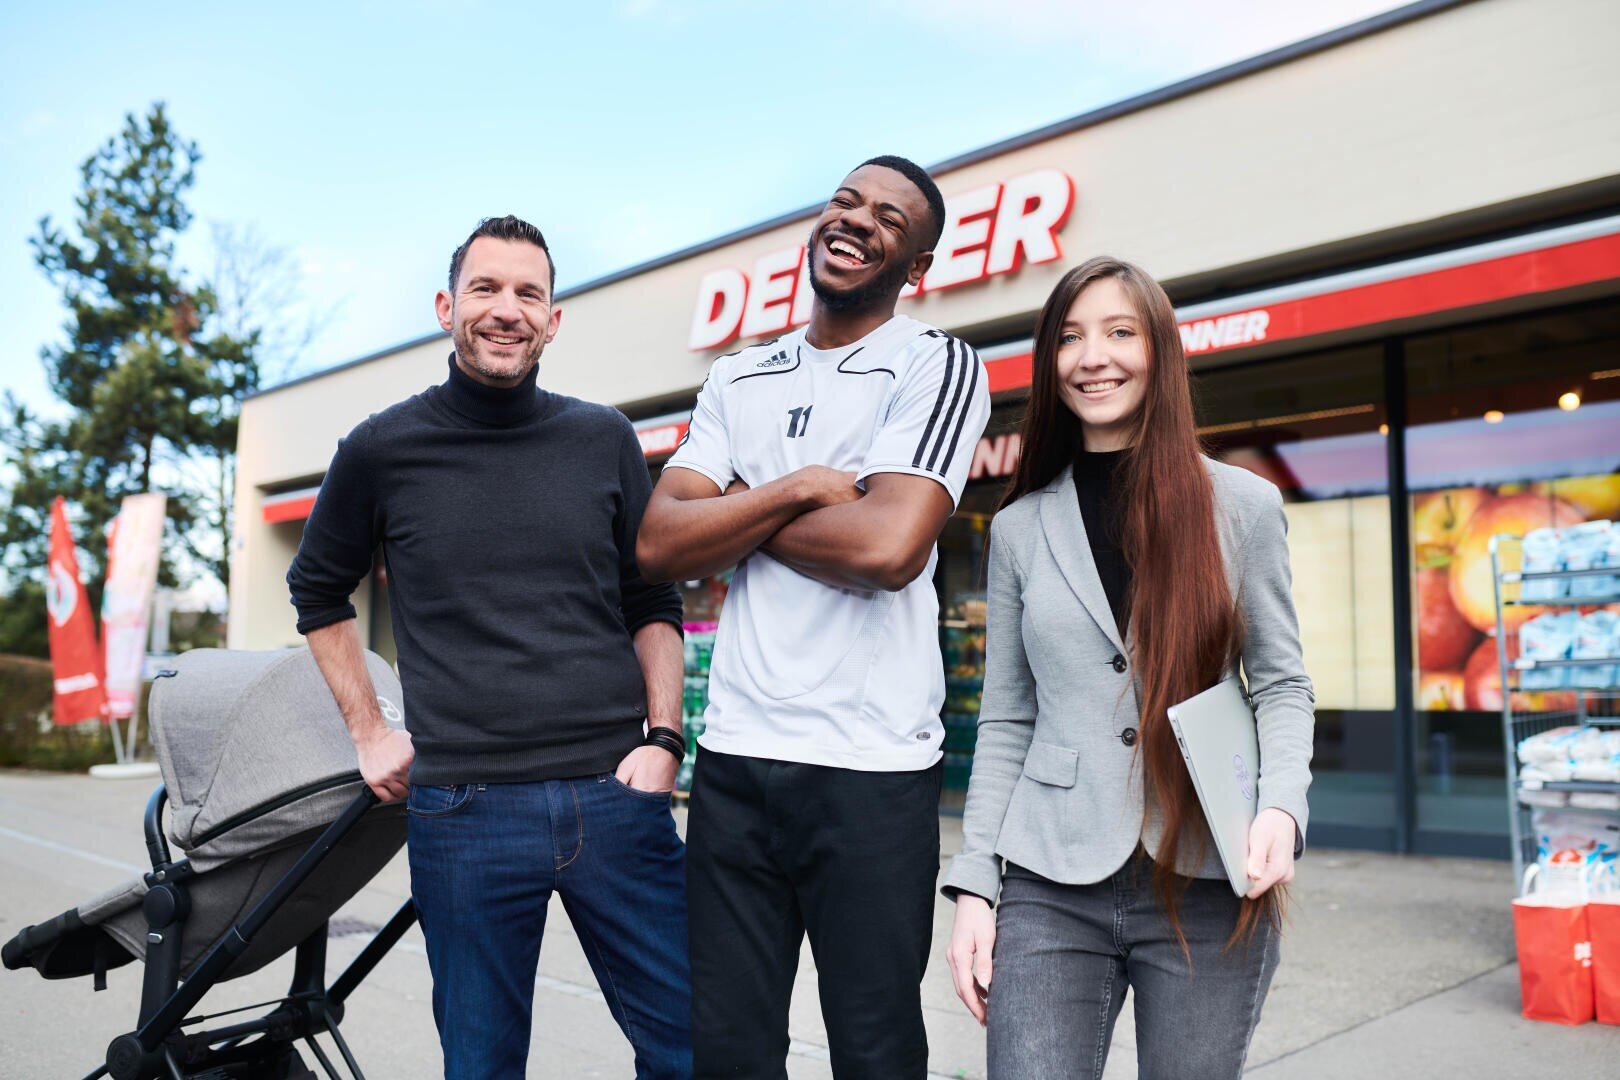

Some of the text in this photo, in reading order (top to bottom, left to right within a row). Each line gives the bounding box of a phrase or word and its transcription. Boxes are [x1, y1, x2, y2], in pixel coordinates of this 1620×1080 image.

[689, 168, 1075, 350] DEER
[1179, 310, 1269, 352] NNER
[786, 404, 813, 438] 11
